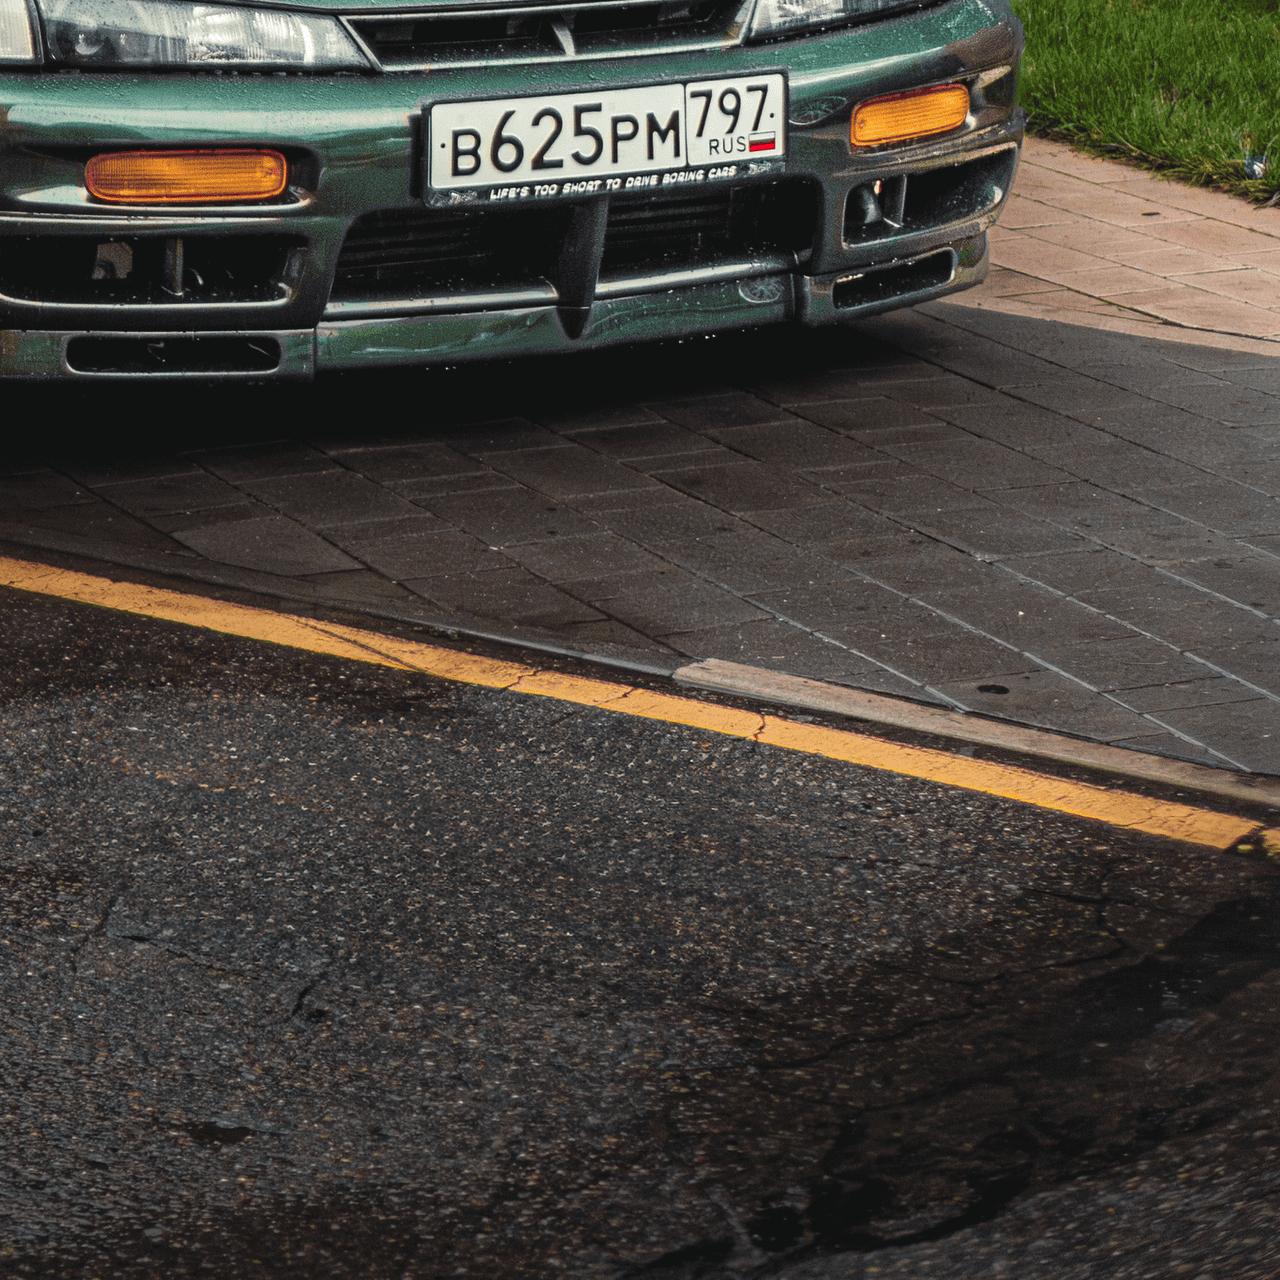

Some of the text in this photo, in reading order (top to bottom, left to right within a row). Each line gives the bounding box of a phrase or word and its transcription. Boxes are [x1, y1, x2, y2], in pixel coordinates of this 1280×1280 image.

[690, 84, 768, 137] 797
[709, 136, 746, 155] RUS
[489, 165, 737, 200] LIFE'S TOO SHORT TO DRIVE BORING CARS
